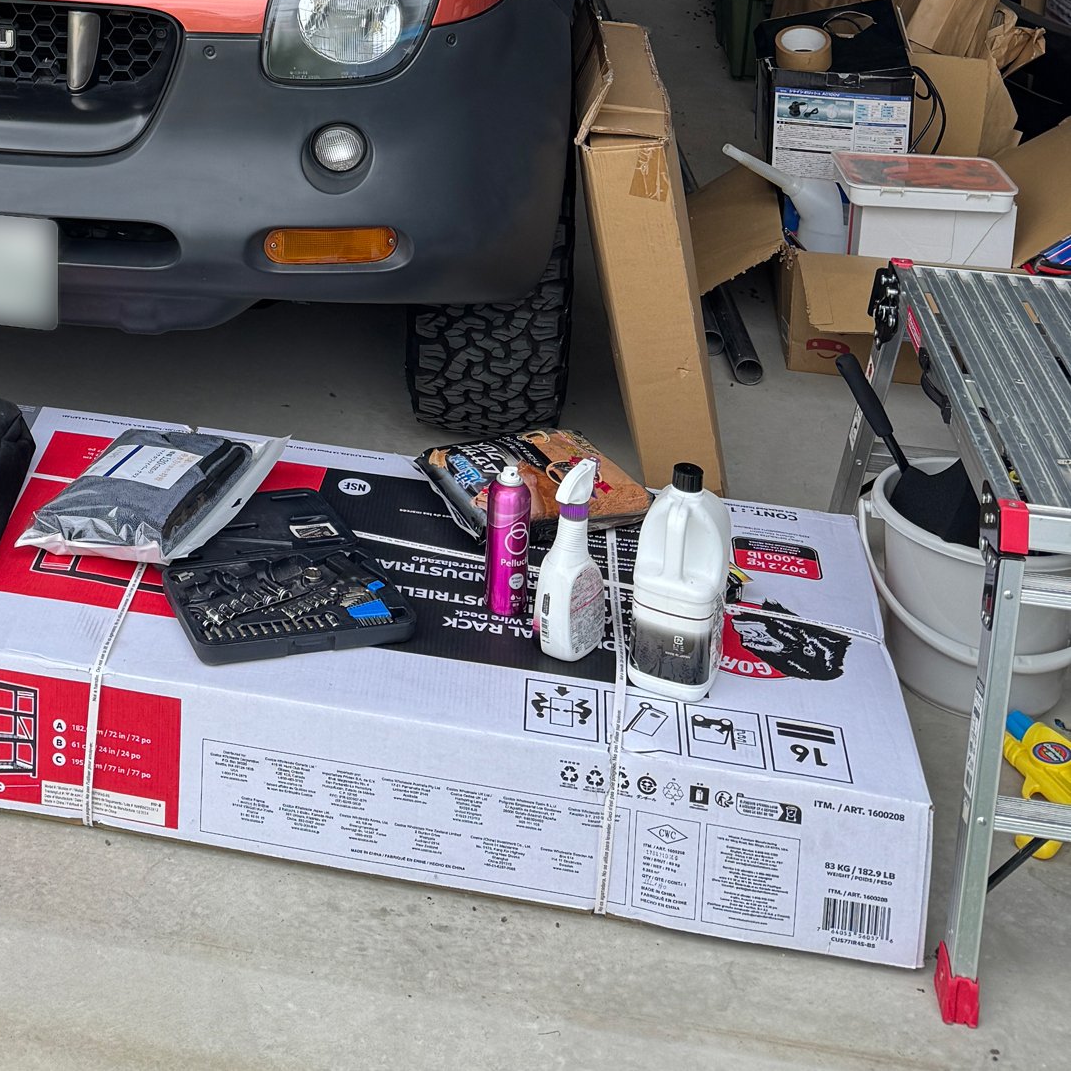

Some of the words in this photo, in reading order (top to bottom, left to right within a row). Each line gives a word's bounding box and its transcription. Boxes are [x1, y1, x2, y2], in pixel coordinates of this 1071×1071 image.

[342, 482, 367, 492] NSF
[751, 509, 798, 521] CONT.
[747, 551, 761, 559] lb
[764, 553, 805, 565] 2,000
[411, 555, 485, 571] entrelazado
[747, 557, 765, 569] kg
[769, 562, 808, 575] 907.2
[455, 609, 487, 621] Deck
[491, 615, 523, 625] Wire
[442, 616, 503, 635] RACK
[56, 722, 63, 730] A
[141, 737, 151, 745] po
[98, 745, 107, 753] 24
[790, 743, 829, 767] 16
[814, 800, 835, 811] ITM.
[837, 803, 843, 813] /
[843, 805, 865, 816] ART.
[868, 809, 905, 822] 1600208
[658, 828, 676, 840] CWC
[825, 861, 835, 870] 83
[837, 863, 851, 873] KG
[852, 865, 857, 874] /
[858, 867, 882, 877] 182.9
[883, 872, 895, 880] LB
[827, 871, 850, 879] WEIGHT
[640, 885, 654, 893] MADE
[828, 888, 842, 896] ITM.
[847, 891, 862, 899] ART.
[863, 894, 888, 903] 1600208
